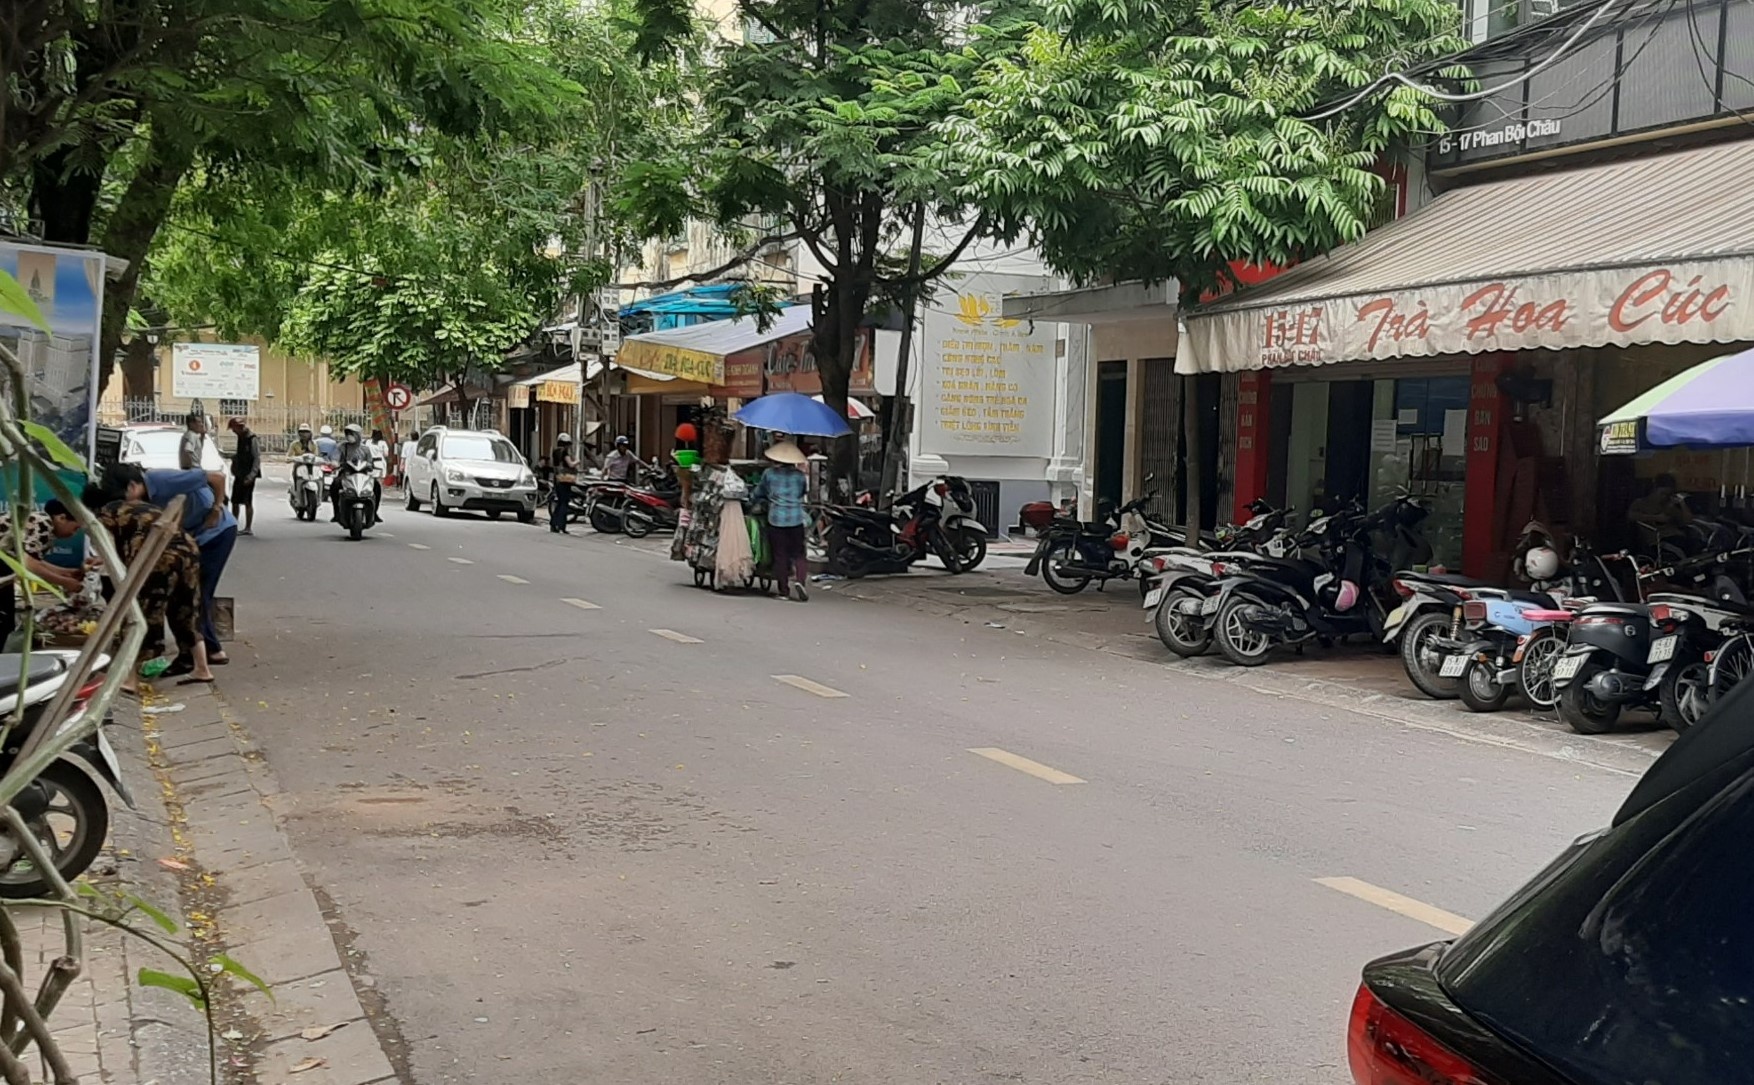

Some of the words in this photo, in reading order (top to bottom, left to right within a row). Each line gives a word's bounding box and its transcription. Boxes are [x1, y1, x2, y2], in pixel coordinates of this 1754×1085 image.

[1459, 133, 1472, 150] 17
[1473, 130, 1503, 148] Phan
[1505, 124, 1525, 144] Bội
[1527, 120, 1561, 138] Châu
[1262, 307, 1323, 348] 15-17
[1357, 298, 1430, 351] Trà
[1460, 282, 1569, 340] Hoa
[1607, 269, 1729, 333] Cúc
